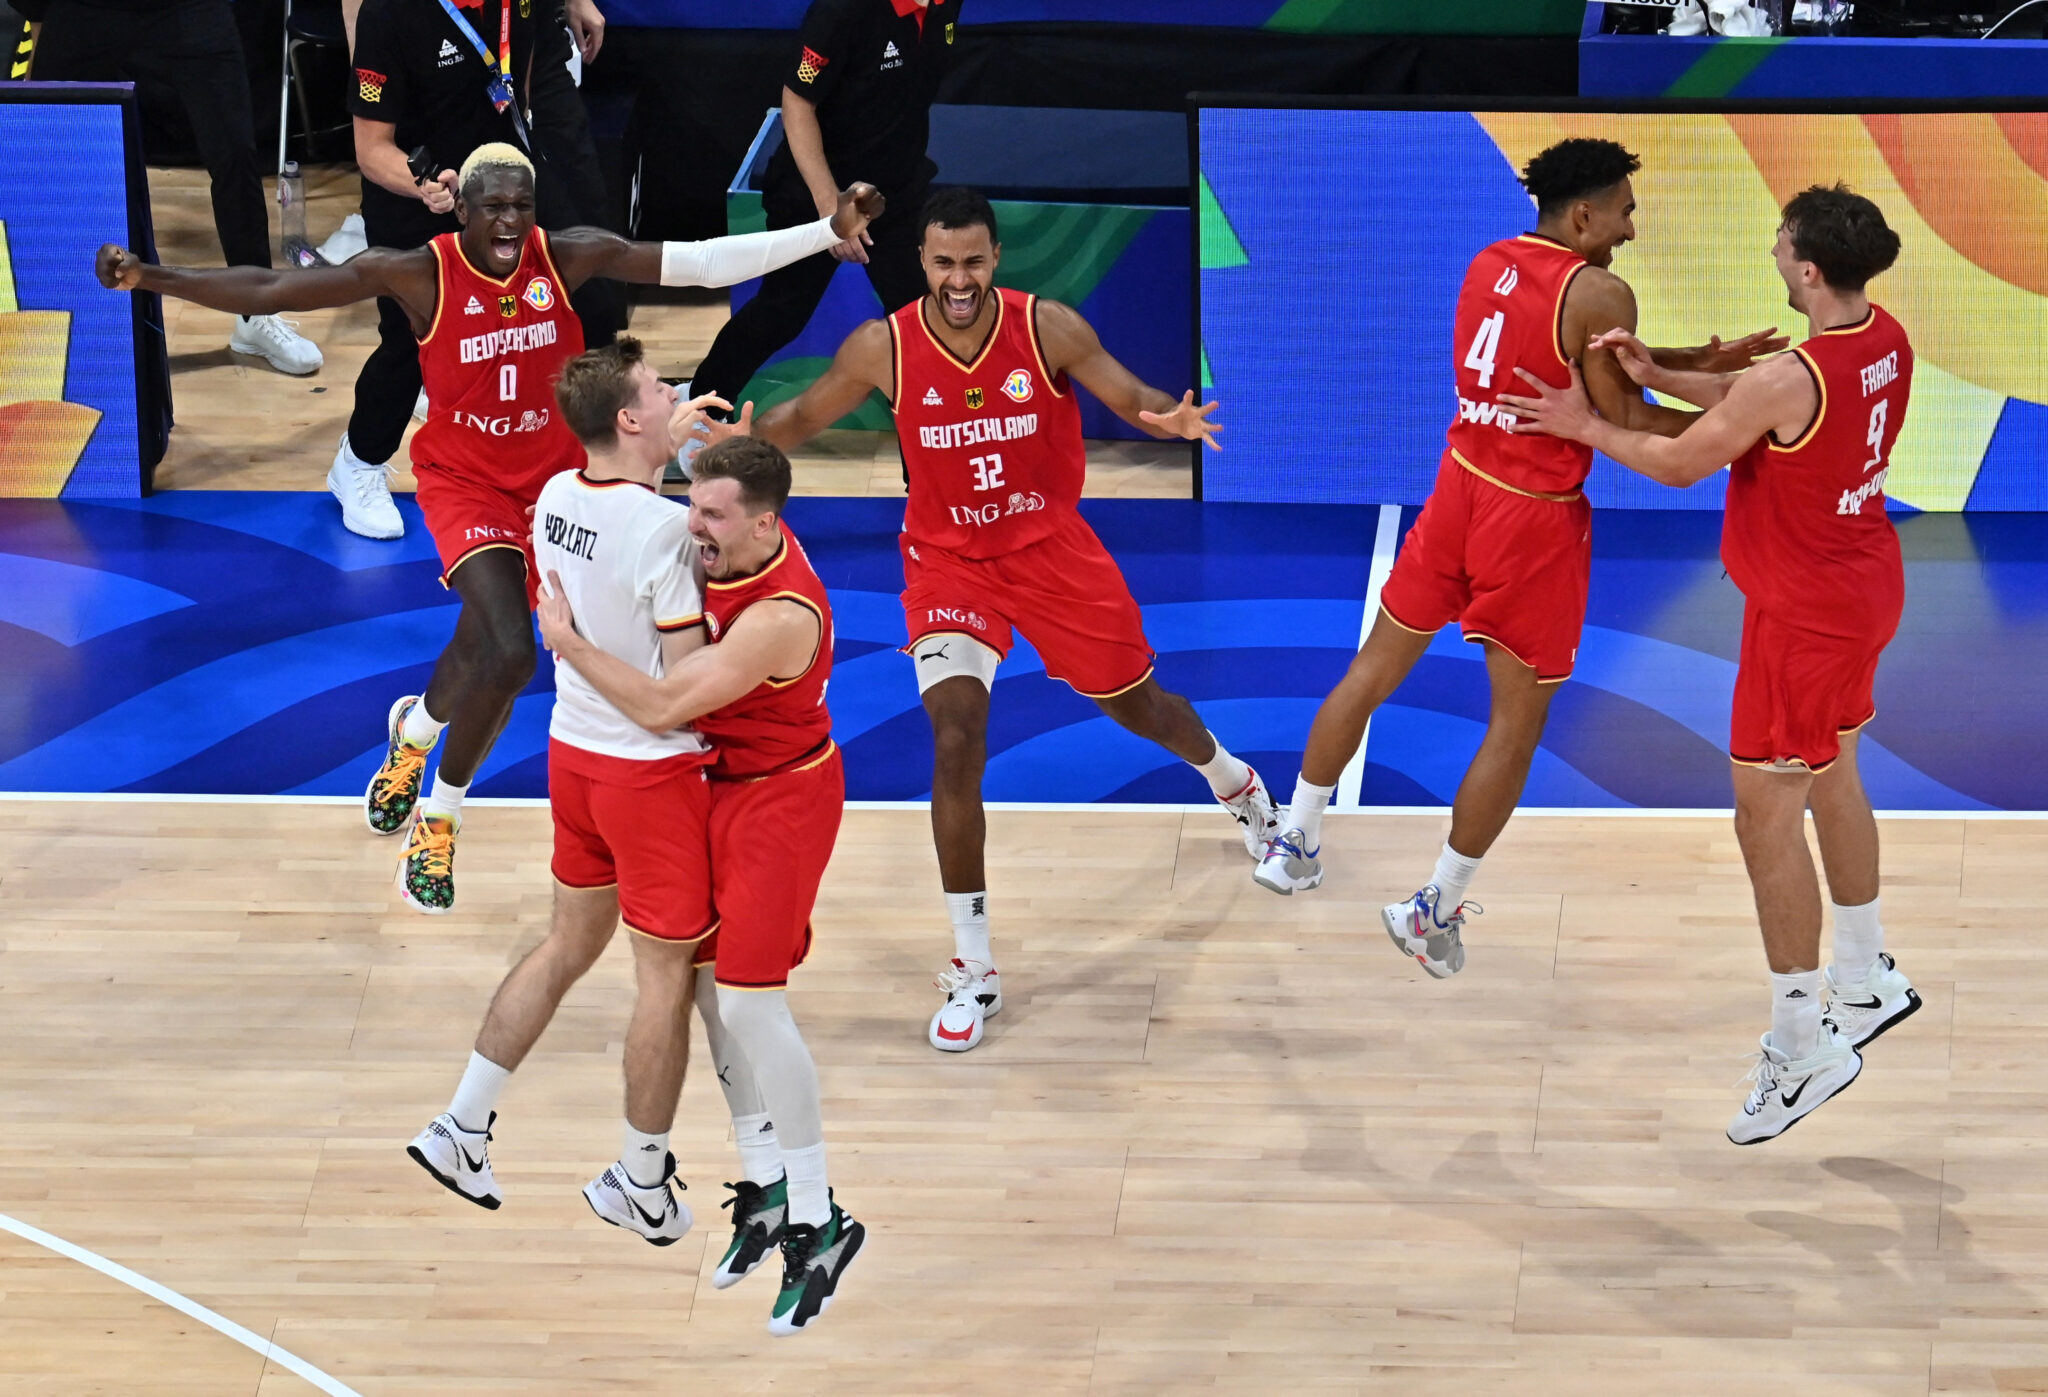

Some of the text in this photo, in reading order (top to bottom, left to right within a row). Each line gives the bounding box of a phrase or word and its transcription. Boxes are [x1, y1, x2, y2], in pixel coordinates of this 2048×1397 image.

[437, 58, 454, 68] ING
[464, 305, 485, 315] PEAK
[459, 320, 557, 364] DEUTSCHLAND
[1464, 311, 1504, 389] 4
[499, 364, 517, 402] 0
[1860, 350, 1898, 398] FRANZ
[922, 397, 943, 406] PEAK
[452, 410, 512, 436] ING
[919, 413, 1038, 449] DEUTSCHLAND
[1862, 398, 1888, 473] 9
[969, 453, 1005, 492] 32
[949, 503, 1001, 528] ING
[927, 608, 966, 623] ING
